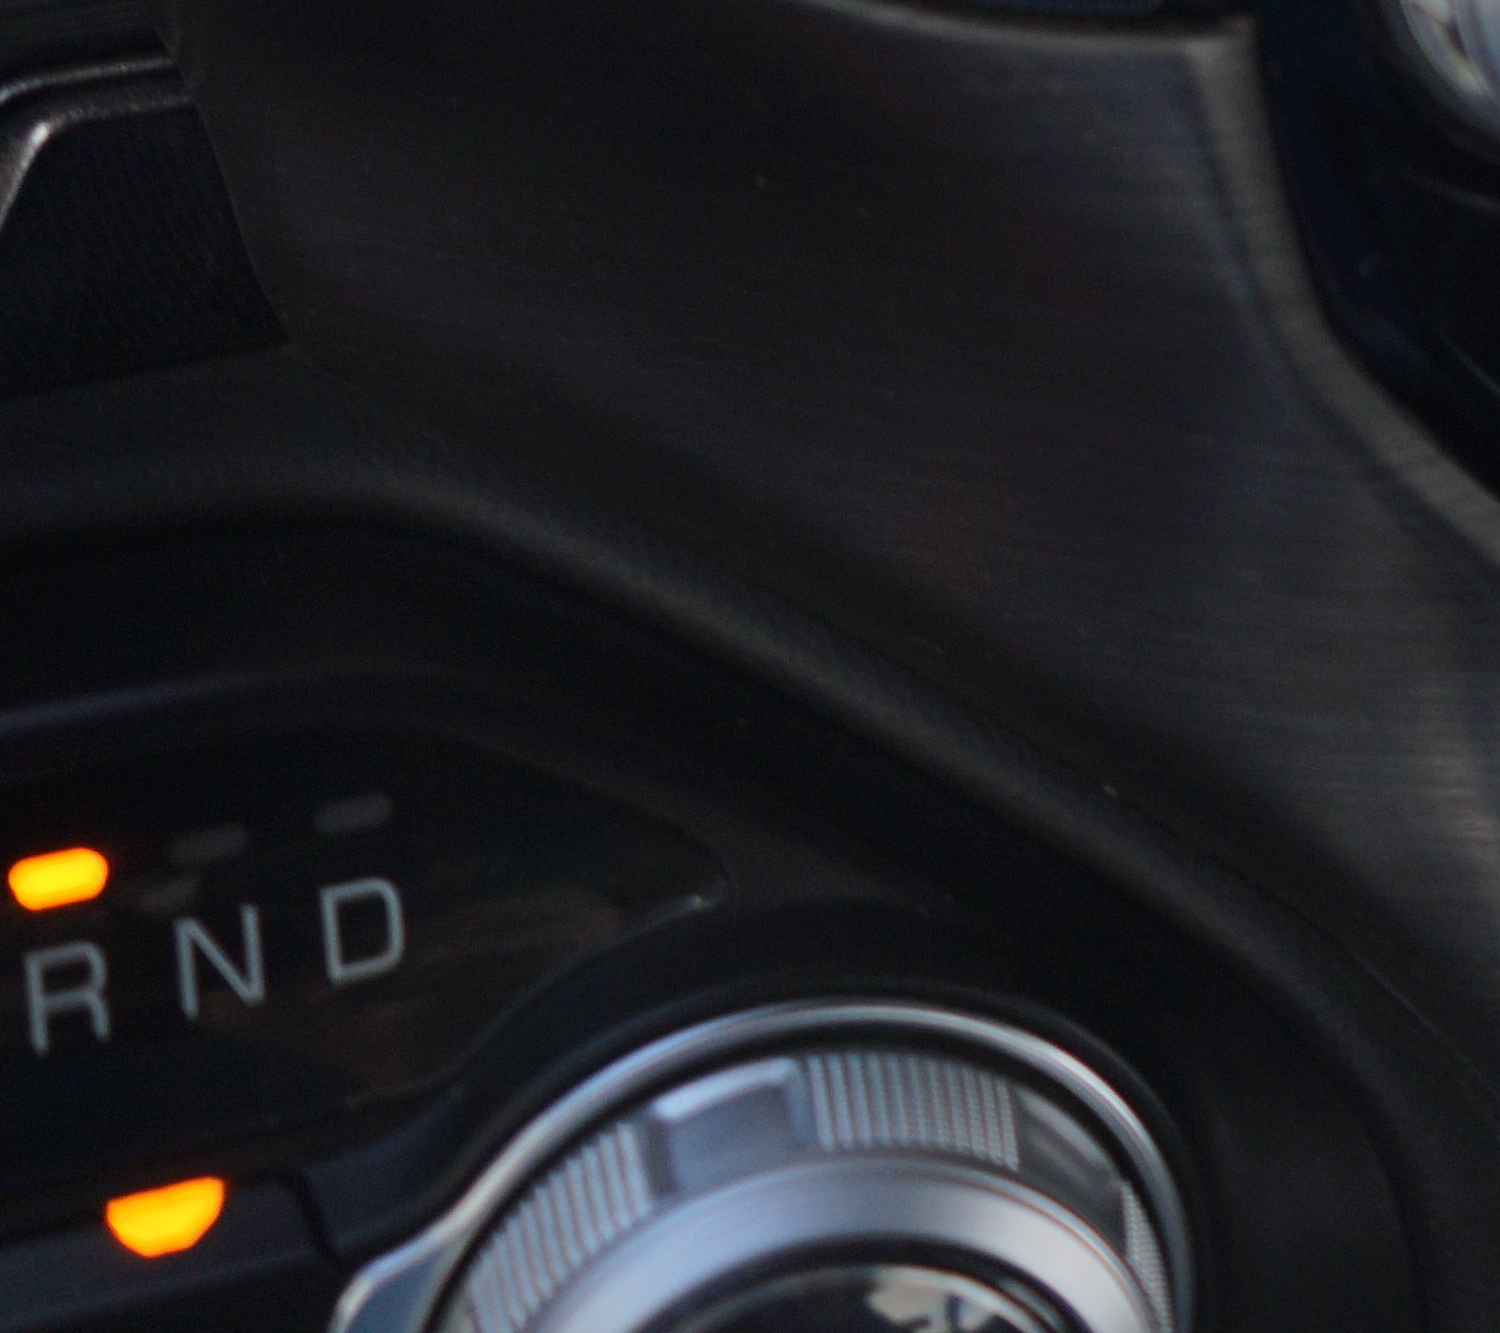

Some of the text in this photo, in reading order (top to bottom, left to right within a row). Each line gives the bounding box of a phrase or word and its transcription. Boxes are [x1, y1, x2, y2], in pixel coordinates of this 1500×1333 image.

[24, 877, 405, 1056] R N D
